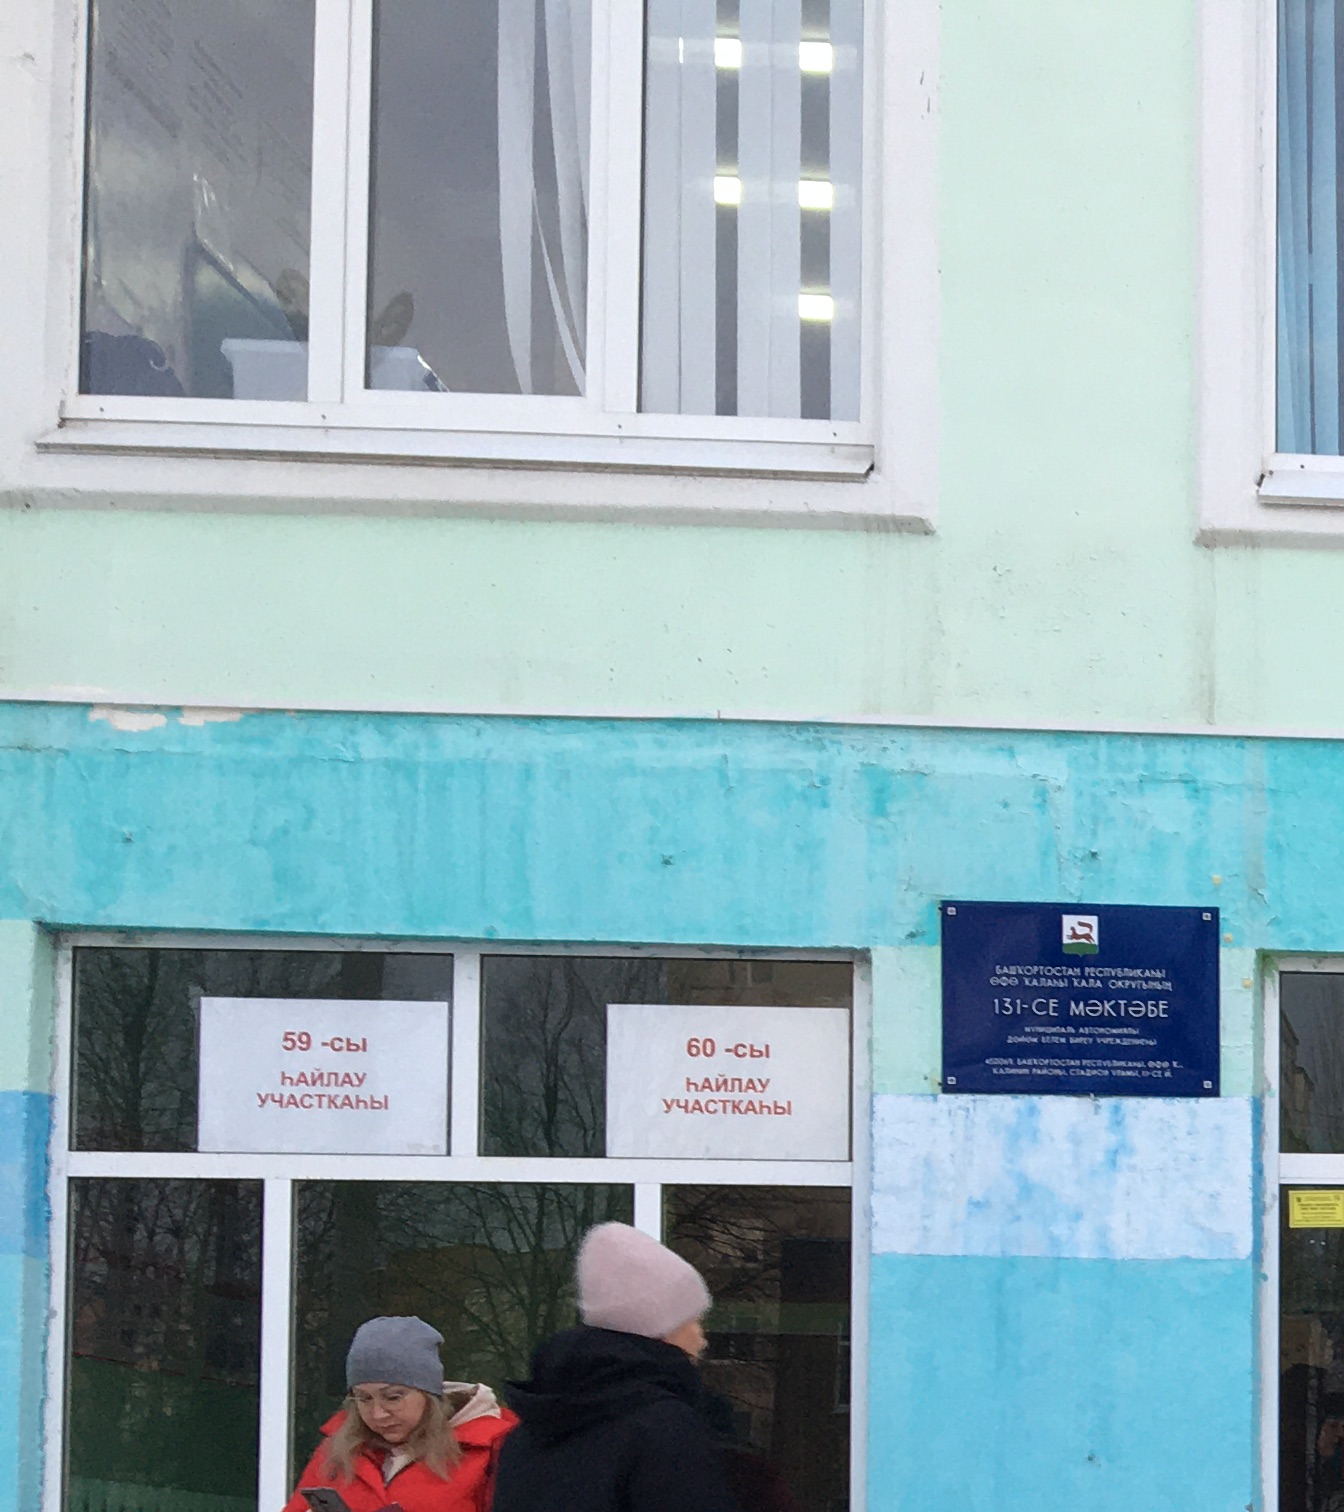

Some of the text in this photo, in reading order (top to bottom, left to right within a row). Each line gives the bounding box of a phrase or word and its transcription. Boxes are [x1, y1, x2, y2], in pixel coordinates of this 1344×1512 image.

[994, 998, 1169, 1018] 131-СЕ МӘКТӘБЕ
[281, 1031, 312, 1051] 59
[686, 1037, 716, 1058] 60
